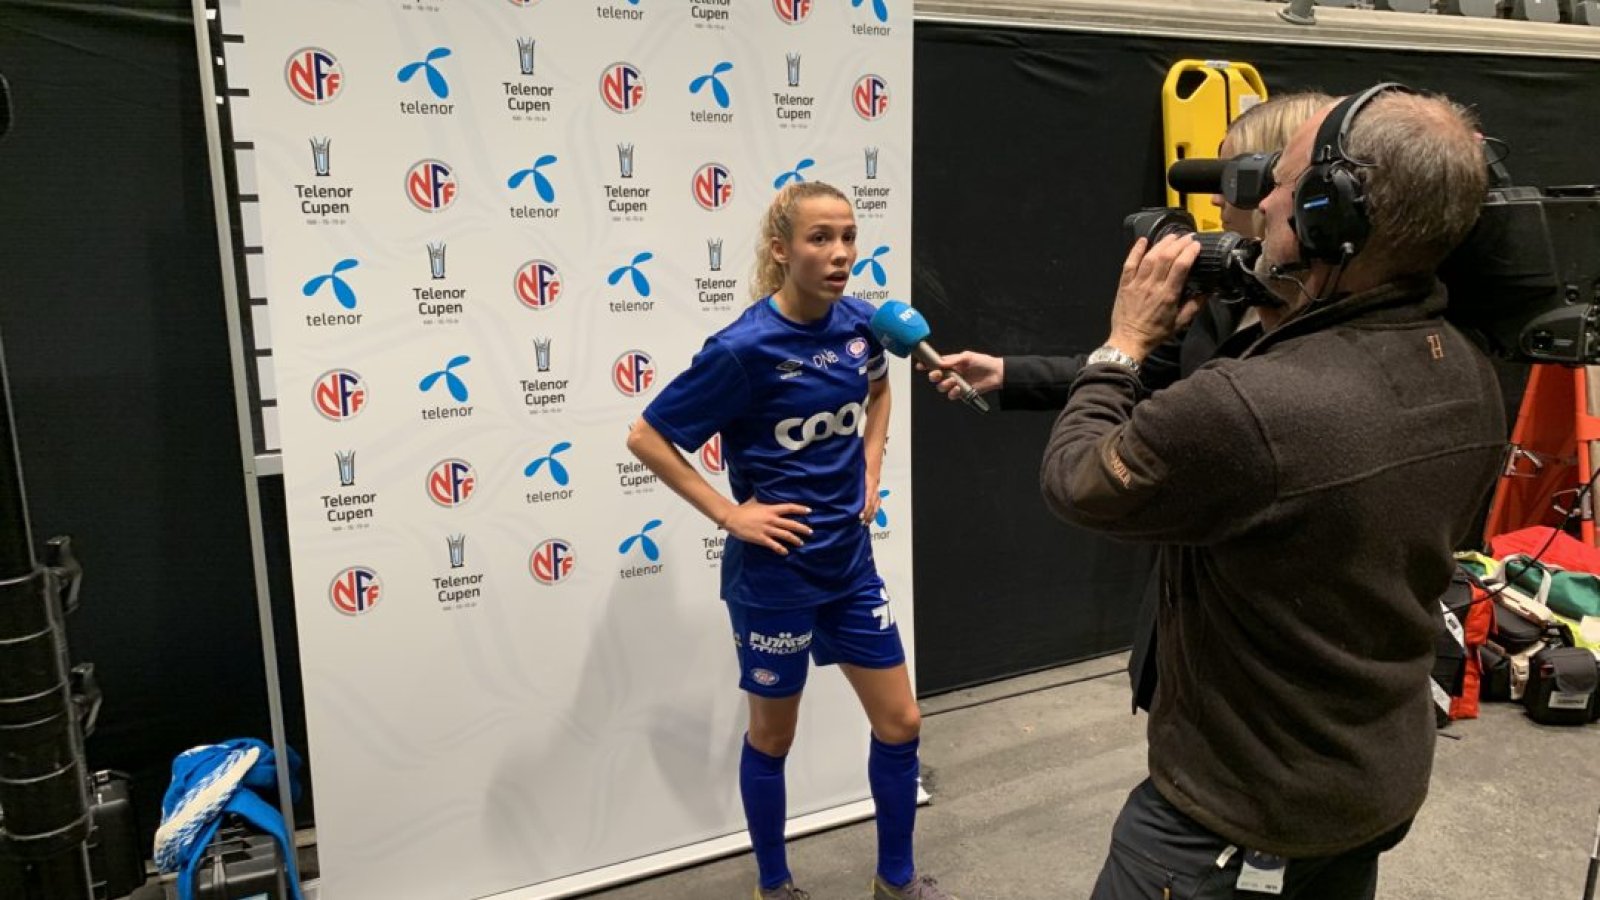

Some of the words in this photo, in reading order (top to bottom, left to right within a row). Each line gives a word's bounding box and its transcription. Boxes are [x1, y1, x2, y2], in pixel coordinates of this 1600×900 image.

[597, 6, 644, 20] telenor
[692, 5, 729, 21] Cupen
[852, 24, 890, 36] telenor
[290, 52, 341, 101] NFF
[502, 82, 553, 96] Telenor
[603, 67, 643, 109] NFF
[508, 97, 550, 112] Cupen
[774, 93, 814, 106] Telenor
[855, 79, 888, 117] NFF
[400, 101, 454, 115] telenor
[776, 107, 811, 120] Cupen
[690, 111, 733, 123] telenor
[295, 184, 354, 198] Telenor
[409, 163, 456, 209] NFF
[604, 185, 650, 198] Telenor
[695, 167, 732, 207] NFF
[852, 186, 890, 197] Telenor
[301, 200, 349, 217] Cupen
[608, 199, 647, 213] Cupen
[855, 198, 887, 210] Cupen
[510, 206, 560, 218] telenor
[517, 265, 561, 306] NFF
[695, 278, 737, 290] Telenor
[412, 287, 466, 300] Telenor
[698, 291, 734, 305] Cupen
[418, 301, 463, 317] Cupen
[609, 300, 655, 313] telenor
[306, 313, 362, 327] telenor
[616, 354, 653, 393] NFF
[520, 379, 569, 392] Telenor
[316, 373, 365, 417] NFF
[525, 392, 565, 406] Cupen
[422, 406, 474, 420] telenor
[616, 462, 649, 474] Telen
[430, 462, 474, 505] NFF
[621, 474, 657, 487] Cupen
[321, 492, 377, 508] Telenor
[526, 489, 574, 504] telenor
[327, 507, 374, 523] Cupen
[702, 537, 725, 549] Tele
[532, 542, 573, 581] NFF
[620, 564, 664, 579] telenor
[432, 573, 484, 590] Telenor
[332, 570, 380, 612] NFF
[437, 586, 481, 603] Cupen
